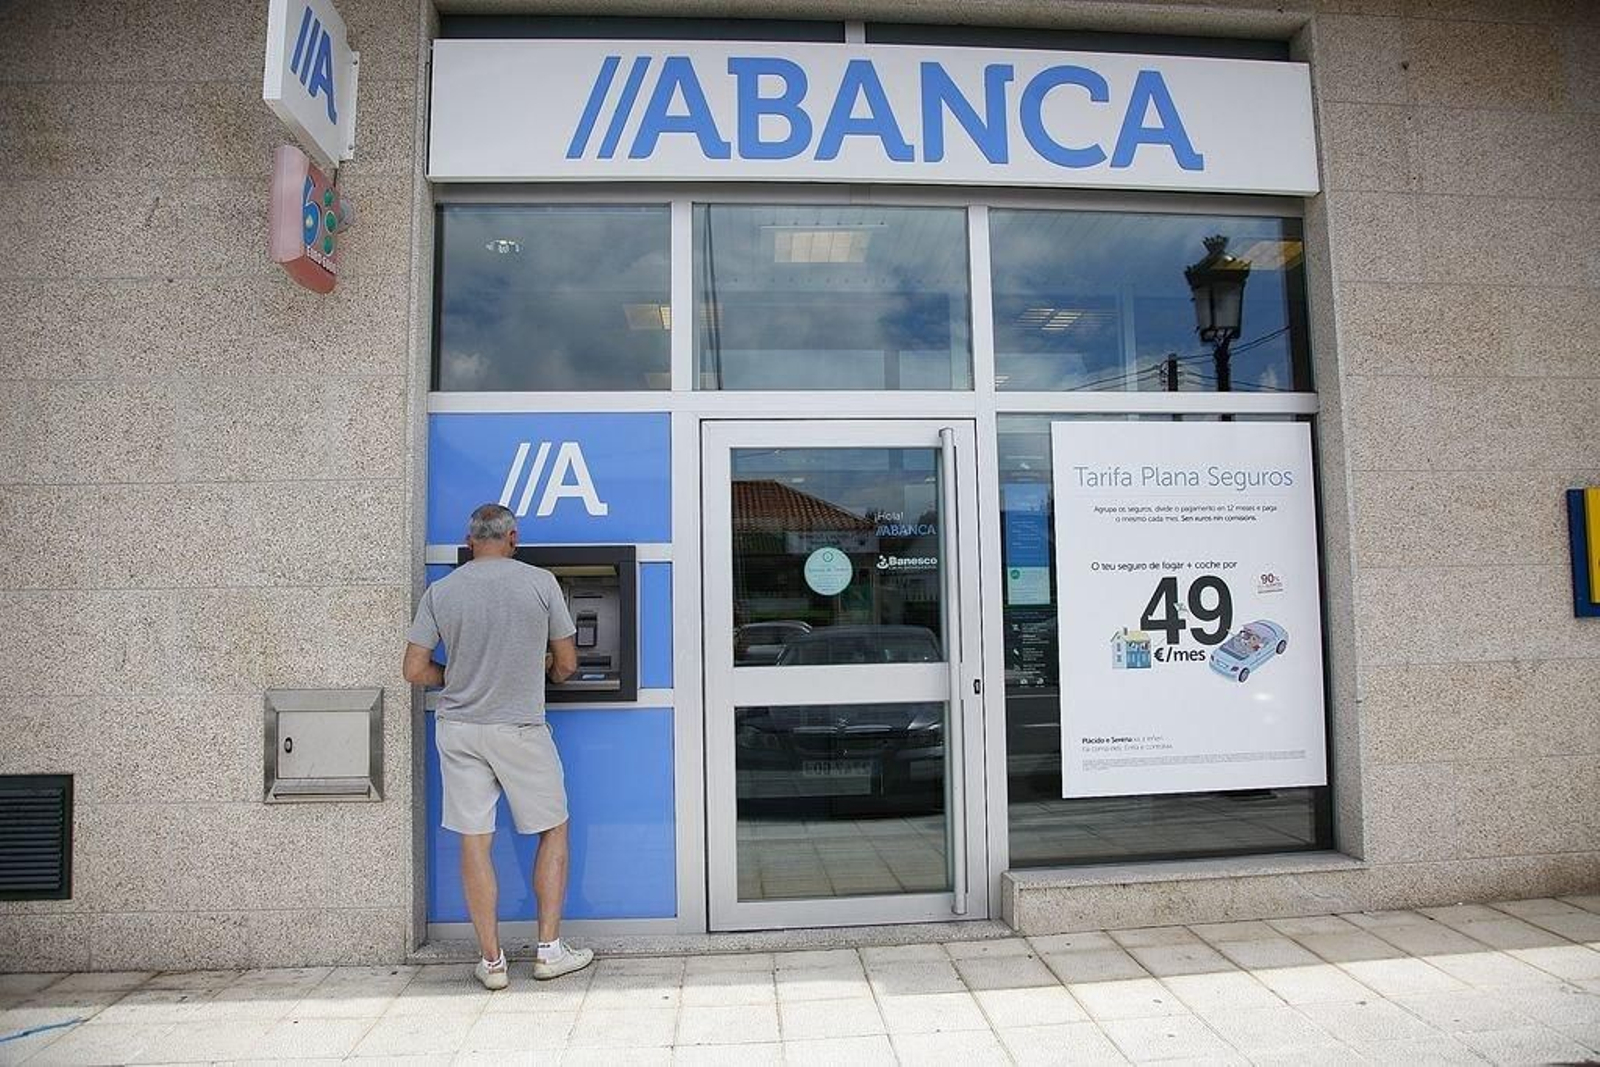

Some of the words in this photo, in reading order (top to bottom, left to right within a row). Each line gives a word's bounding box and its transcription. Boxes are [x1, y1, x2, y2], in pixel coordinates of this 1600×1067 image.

[1074, 466, 1133, 488] Tarifa
[1141, 465, 1200, 487] Plana
[1208, 465, 1294, 491] Seguros
[888, 556, 938, 566] Banesco
[1091, 562, 1100, 571] O
[1102, 563, 1116, 571] teu
[1117, 563, 1147, 572] seguro
[1149, 561, 1160, 570] de
[1162, 561, 1185, 572] fogar
[1195, 561, 1221, 570] coche
[1223, 561, 1238, 571] por
[1140, 575, 1234, 646] 49
[1153, 647, 1206, 662] €/mes
